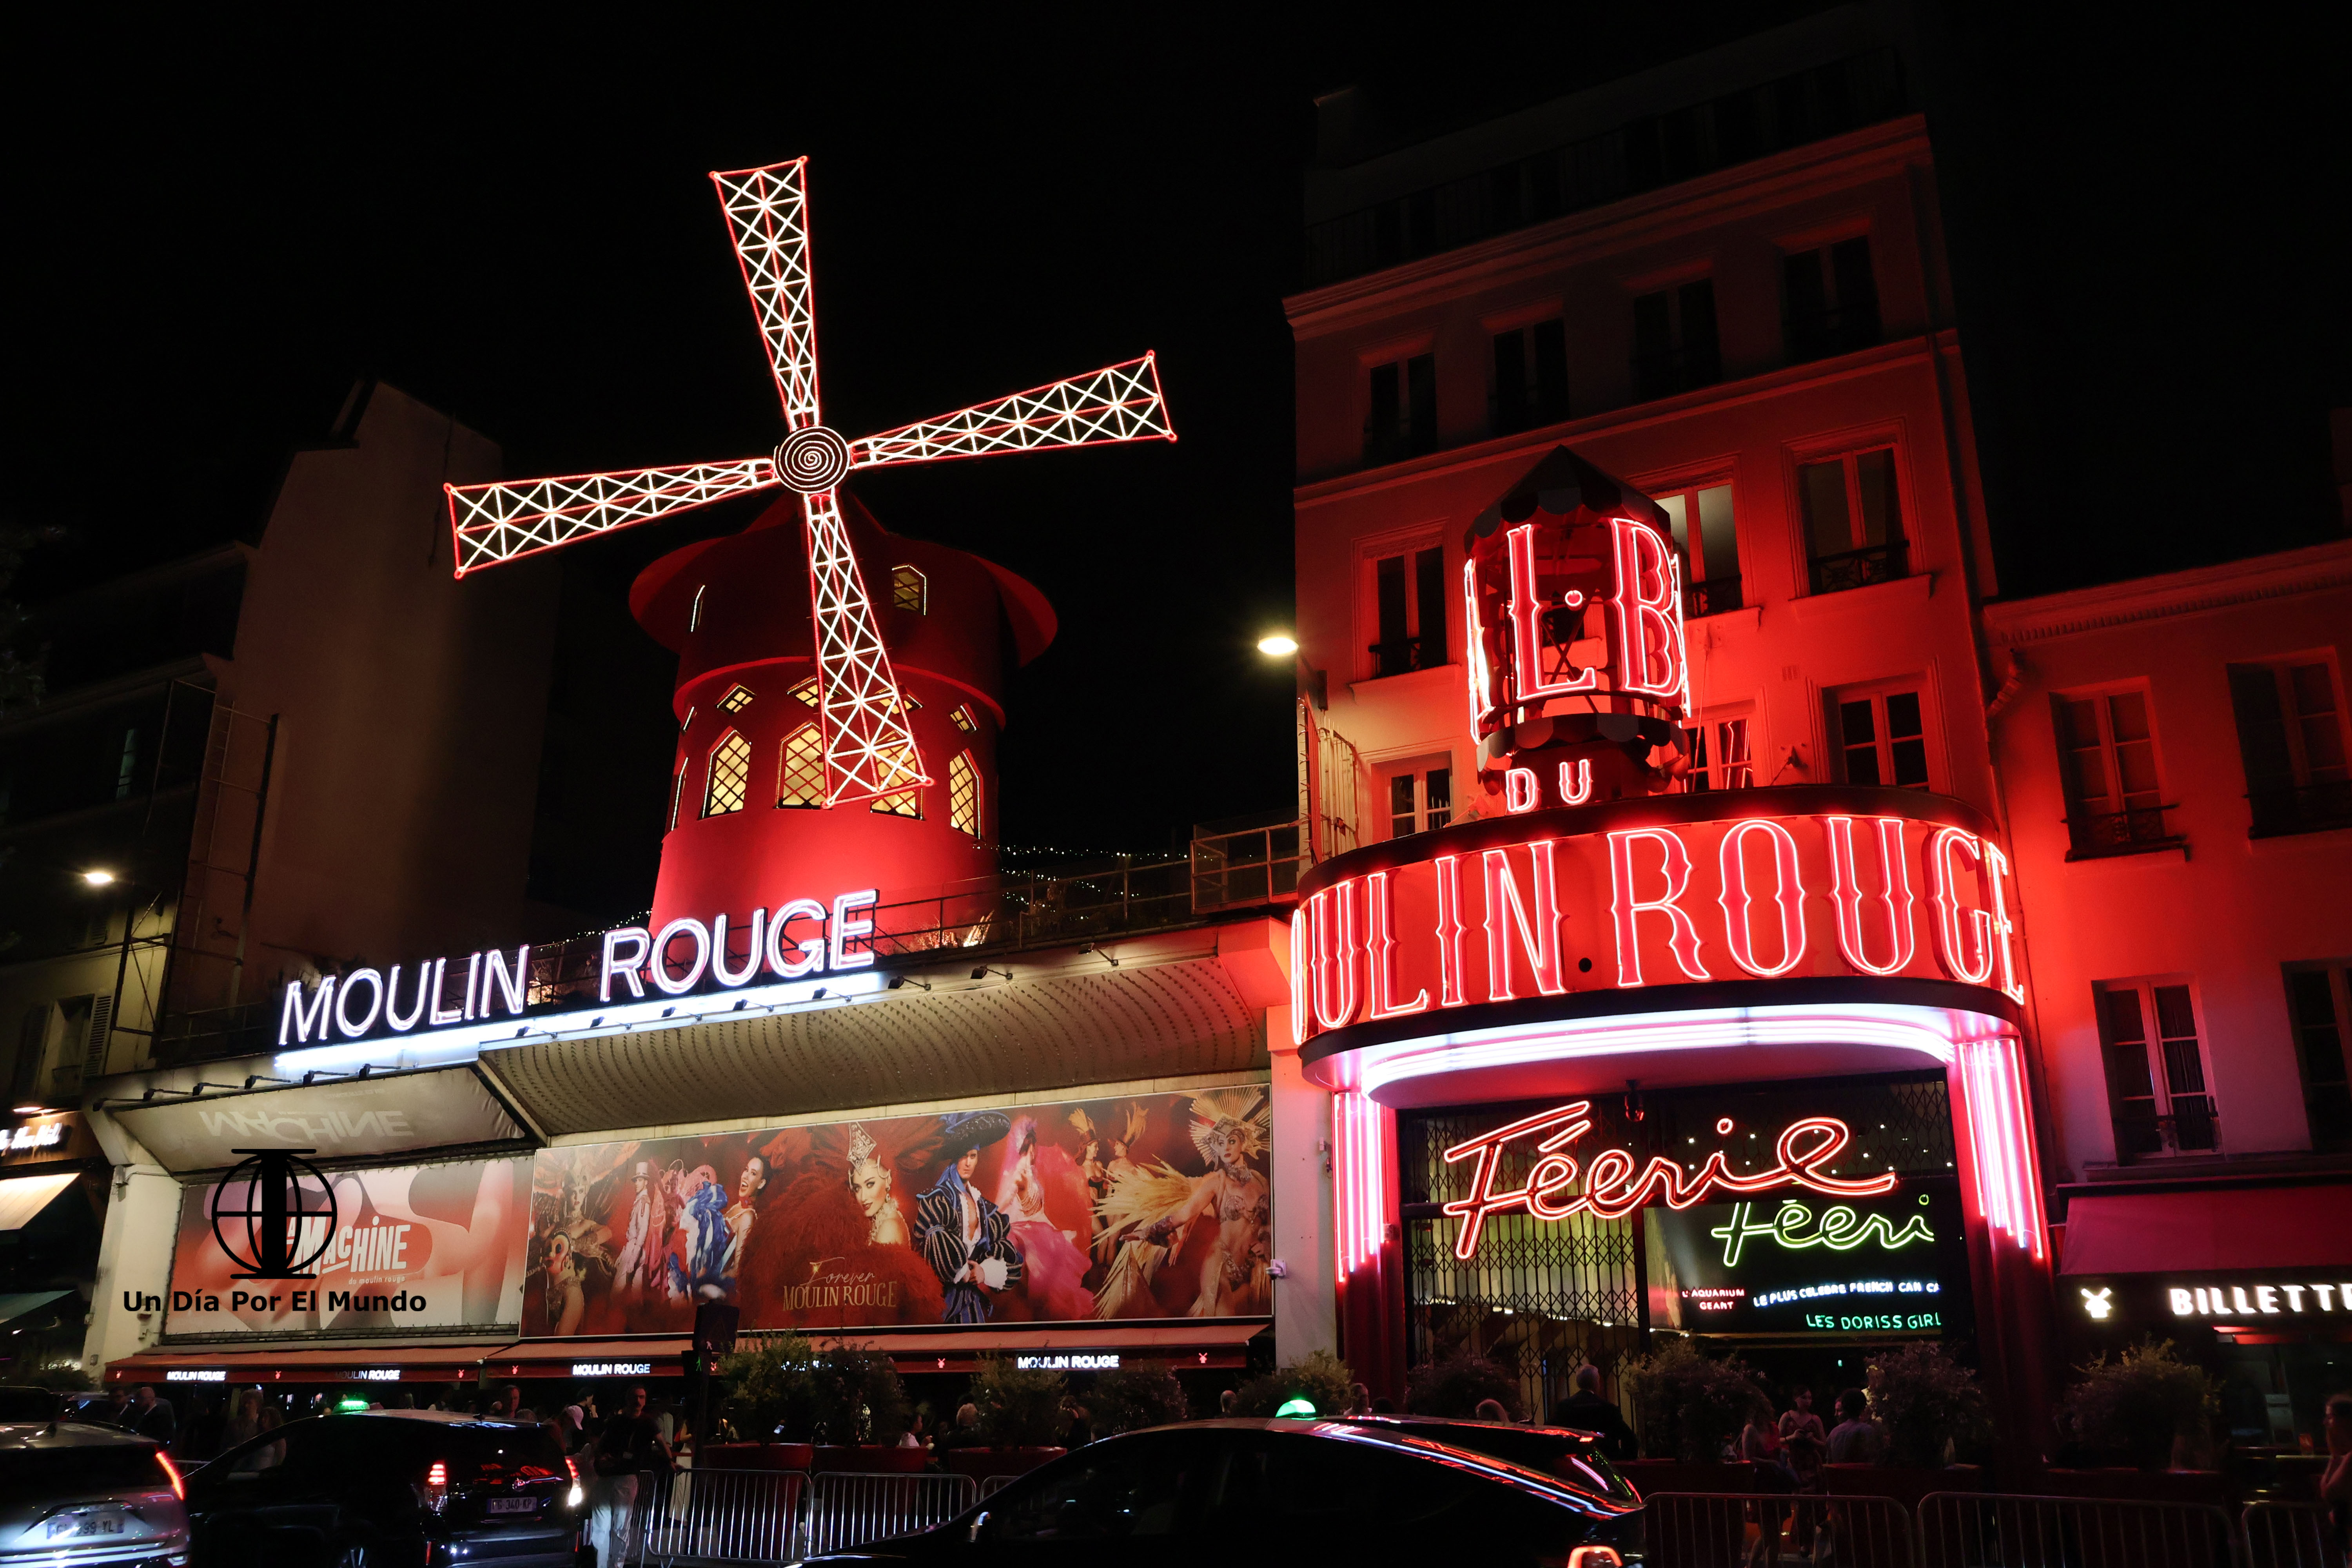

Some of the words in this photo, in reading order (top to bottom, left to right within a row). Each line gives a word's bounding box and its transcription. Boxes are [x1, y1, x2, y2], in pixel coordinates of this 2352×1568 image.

[1505, 759, 1592, 813] DU
[1606, 816, 2024, 1005] ROUGE
[278, 944, 530, 1046] MOULIN
[599, 889, 880, 1002] ROUGE
[359, 1276, 382, 1284] moulin
[800, 1257, 875, 1294] Forever
[783, 1285, 839, 1311] MOULIN
[843, 1281, 898, 1308] ROUGE
[1753, 1295, 1768, 1307] LE
[1769, 1290, 1798, 1304] PLUS
[1849, 1281, 1893, 1292] FRENCH
[1898, 1282, 1921, 1292] CAN
[1699, 1301, 1733, 1310] GEANT
[1806, 1314, 1834, 1328] LES
[1841, 1315, 1902, 1329] DORISS
[1907, 1312, 1941, 1329] GIRL
[573, 1364, 612, 1375] MOULIN
[614, 1363, 650, 1374] ROUGE
[1018, 1356, 1069, 1368] MOULIN
[1071, 1355, 1119, 1368] ROUGE
[167, 1371, 197, 1380] MOULIN
[198, 1371, 226, 1381] ROUGE
[368, 1370, 400, 1380] ROUGE
